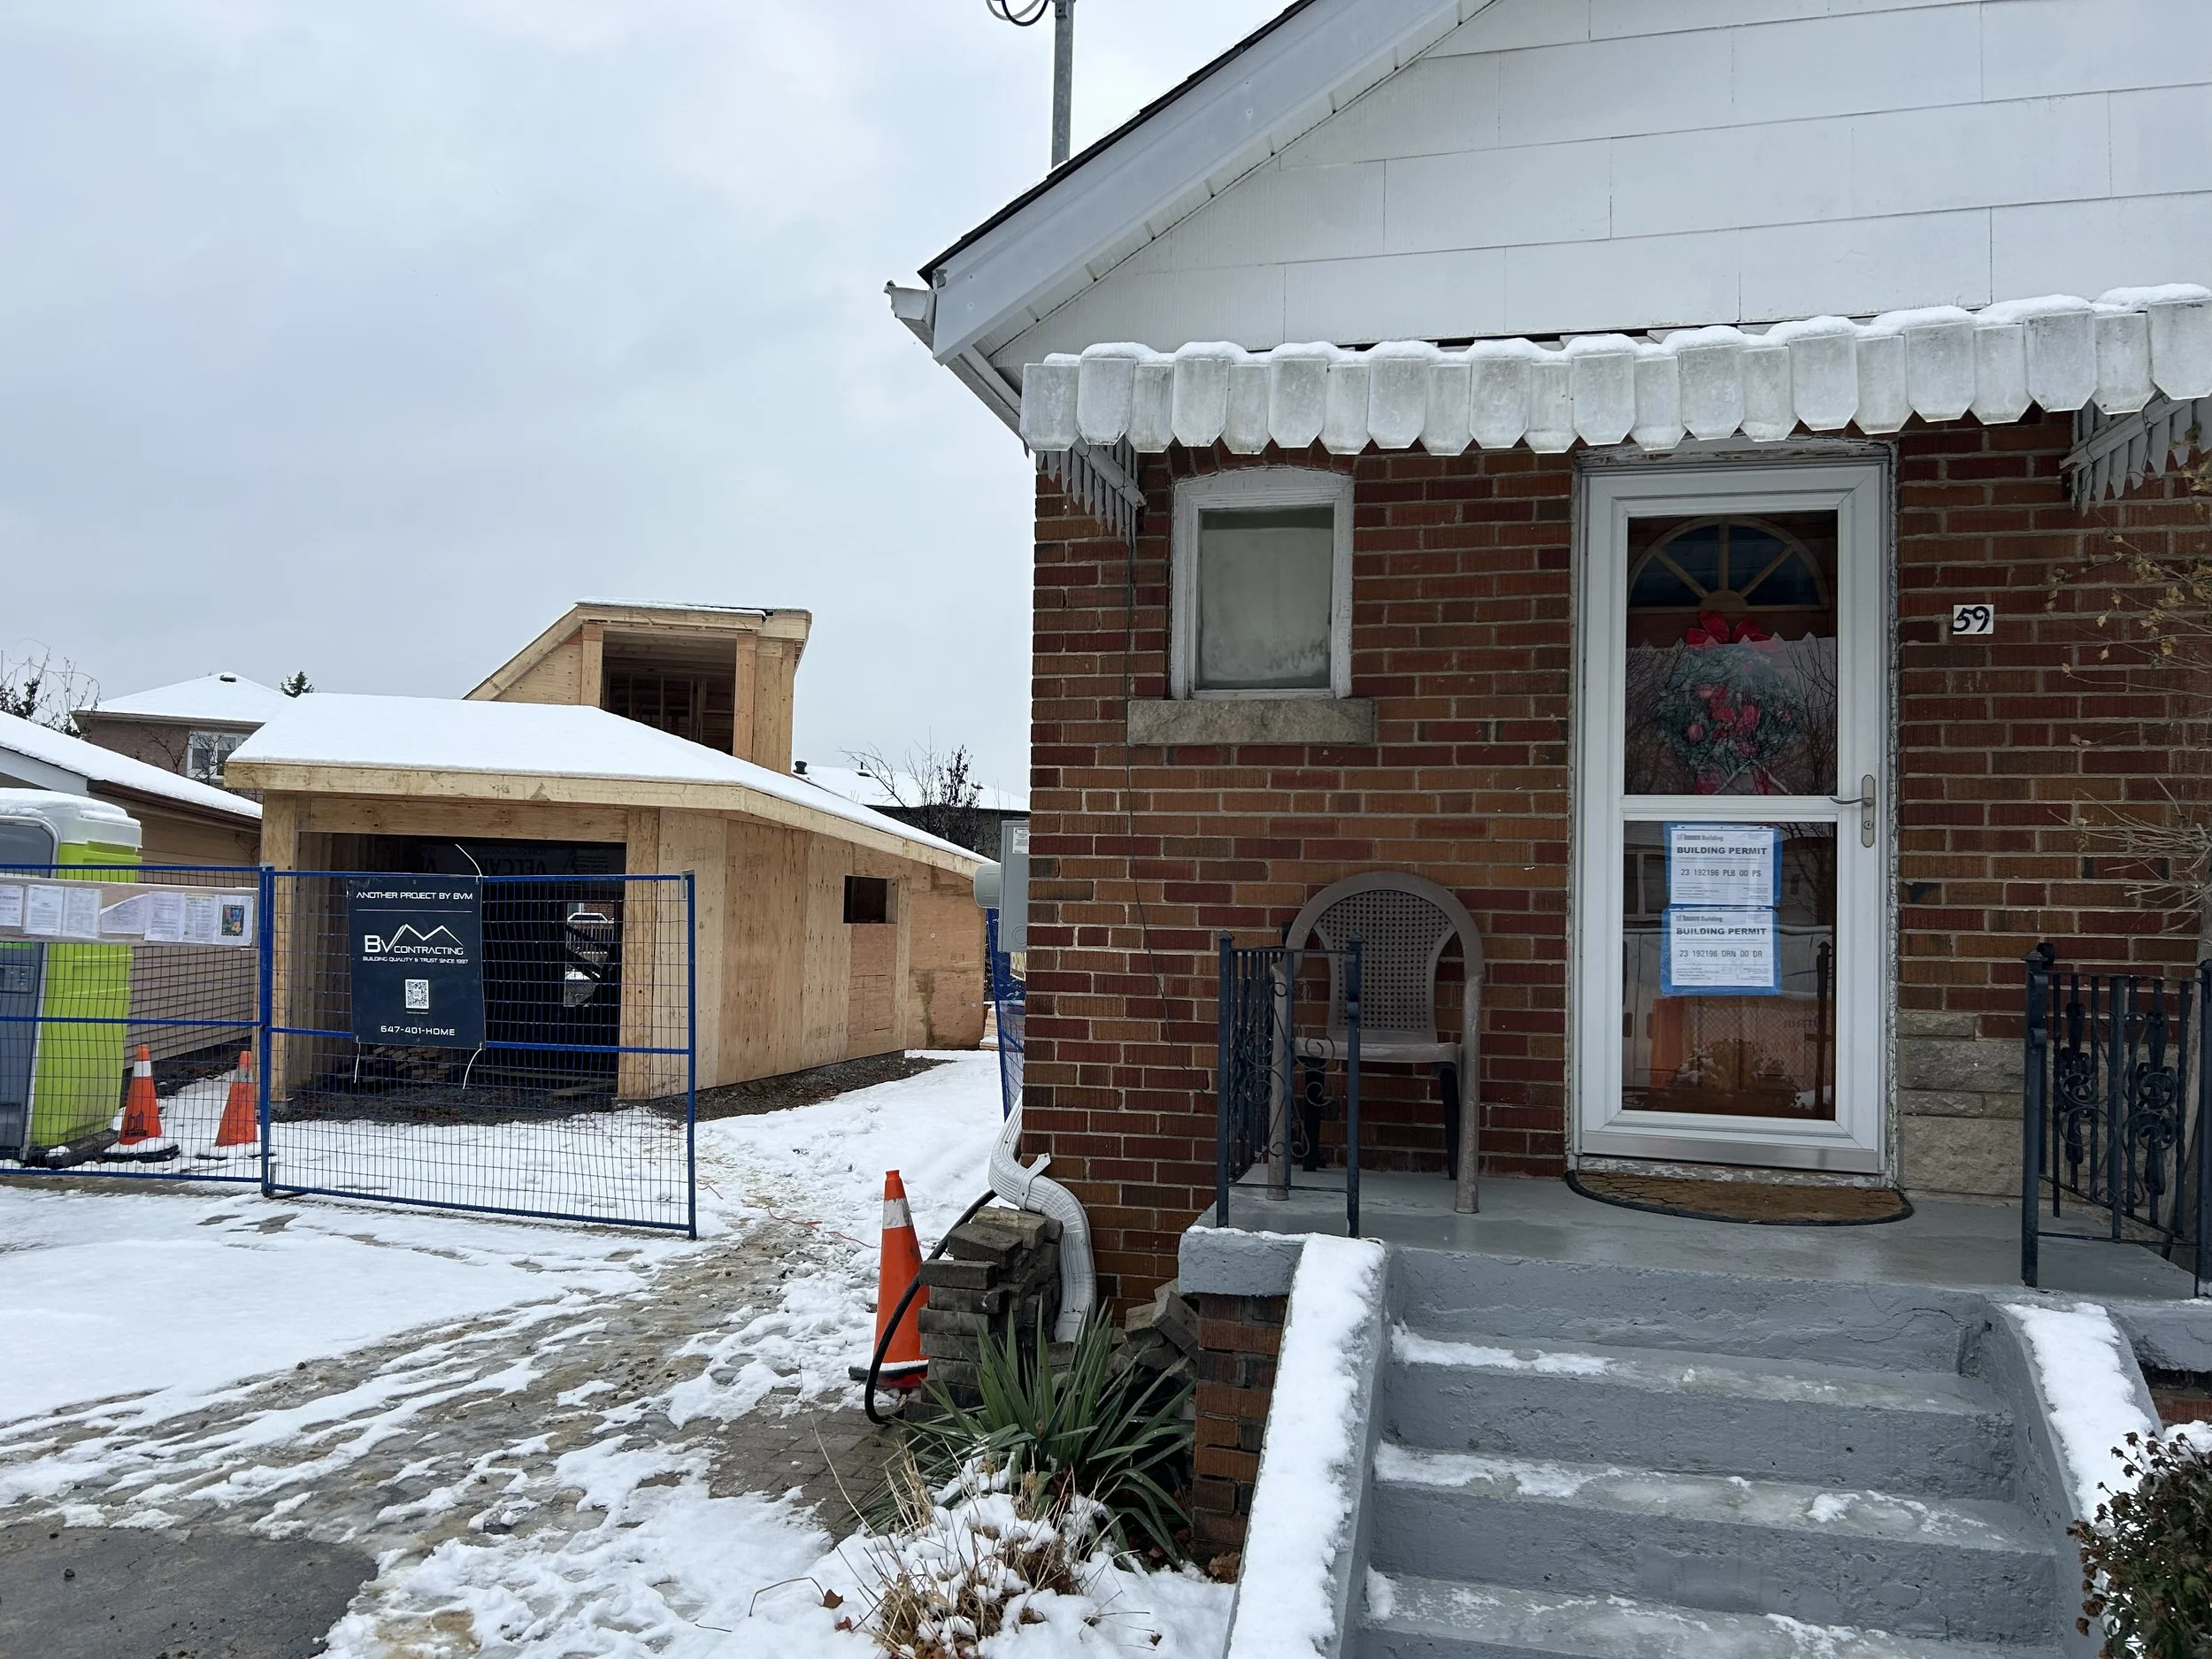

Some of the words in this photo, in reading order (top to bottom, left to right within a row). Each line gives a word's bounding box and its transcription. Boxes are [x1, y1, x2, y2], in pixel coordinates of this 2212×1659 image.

[1950, 606, 1990, 632] 59
[394, 946, 464, 955] CONTRACTING
[380, 1025, 456, 1036] 647-401-HOME
